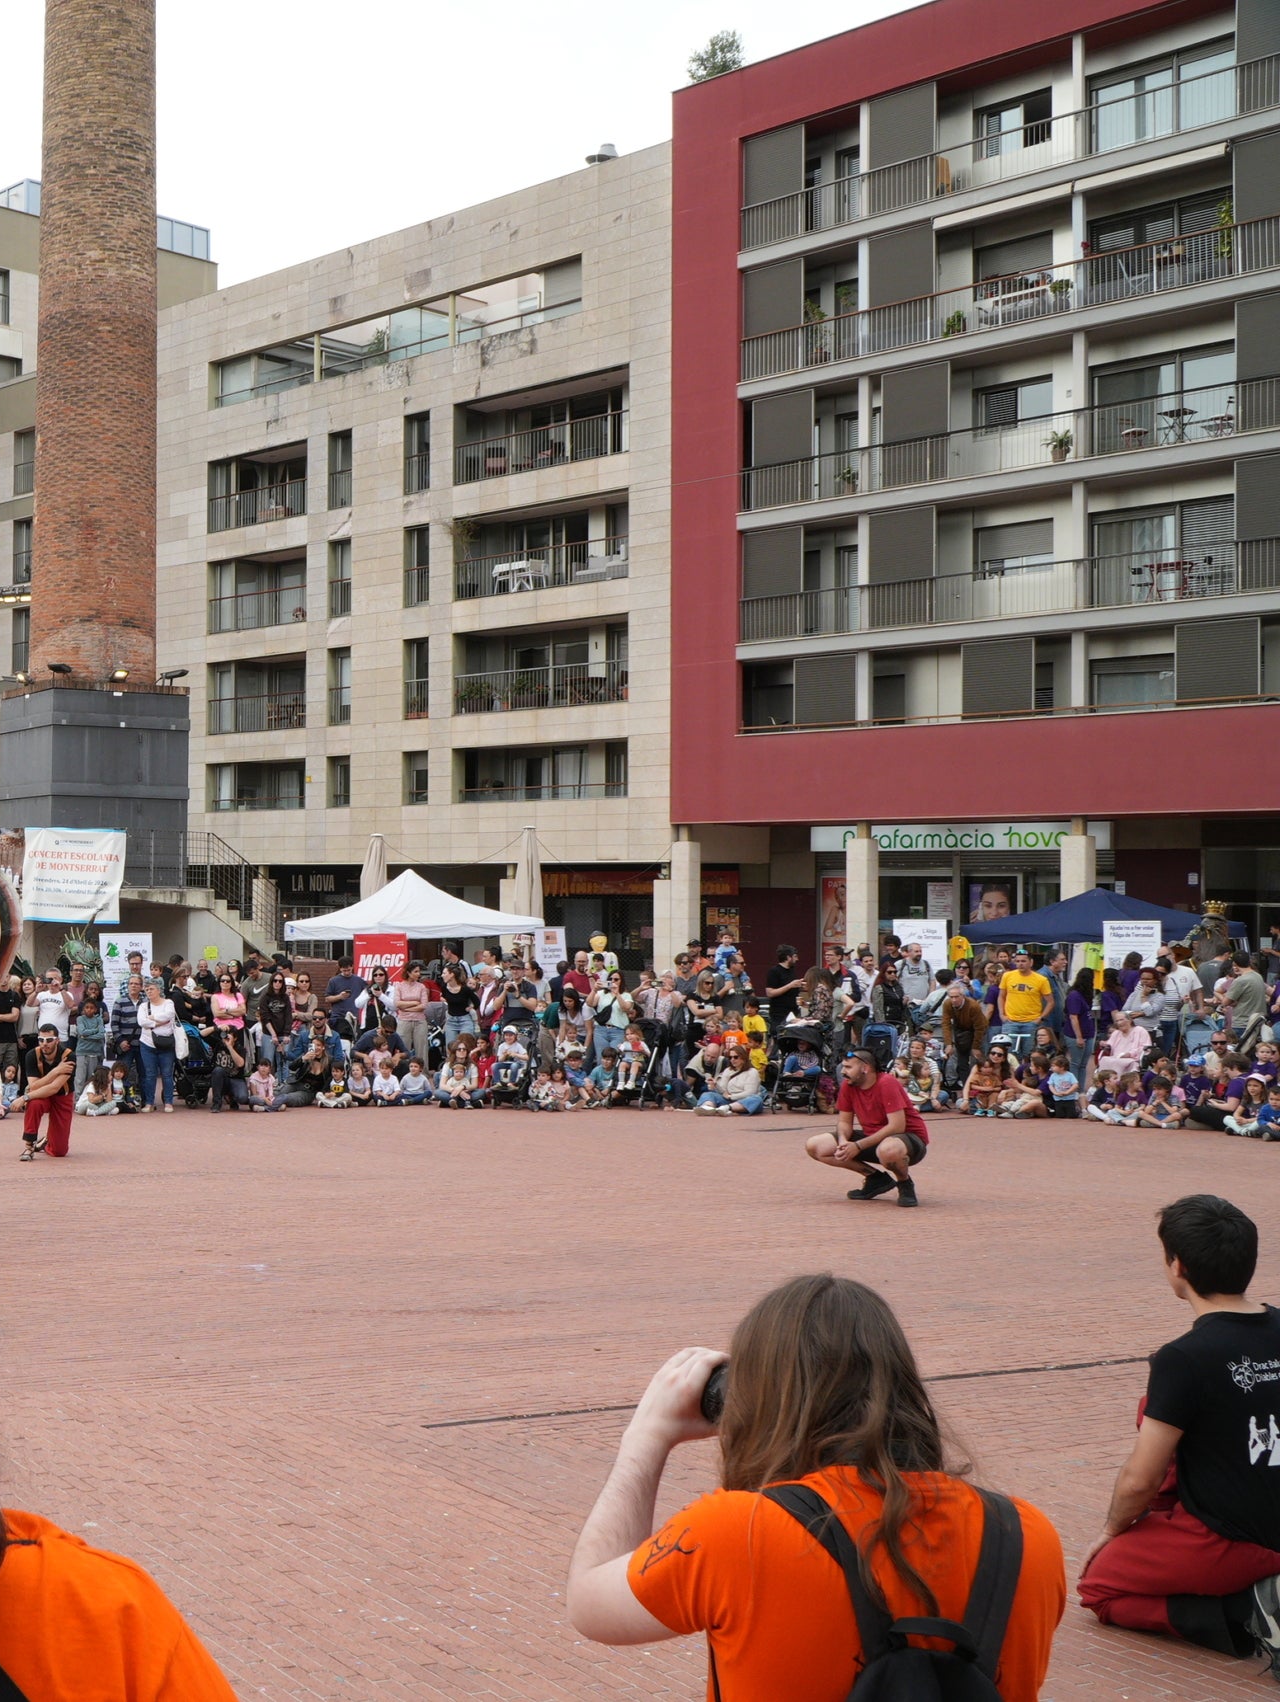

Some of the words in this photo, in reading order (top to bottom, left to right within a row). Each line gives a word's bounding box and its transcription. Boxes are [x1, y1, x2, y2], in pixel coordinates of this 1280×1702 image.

[842, 829, 995, 849] Pafarmàcia
[28, 850, 68, 860] CONCERT
[69, 852, 120, 863] ESCOLANIA
[48, 862, 109, 873] MONTSERRAT
[291, 874, 304, 892] LA
[358, 953, 405, 968] MAGIC
[1252, 1361, 1269, 1371] Drac
